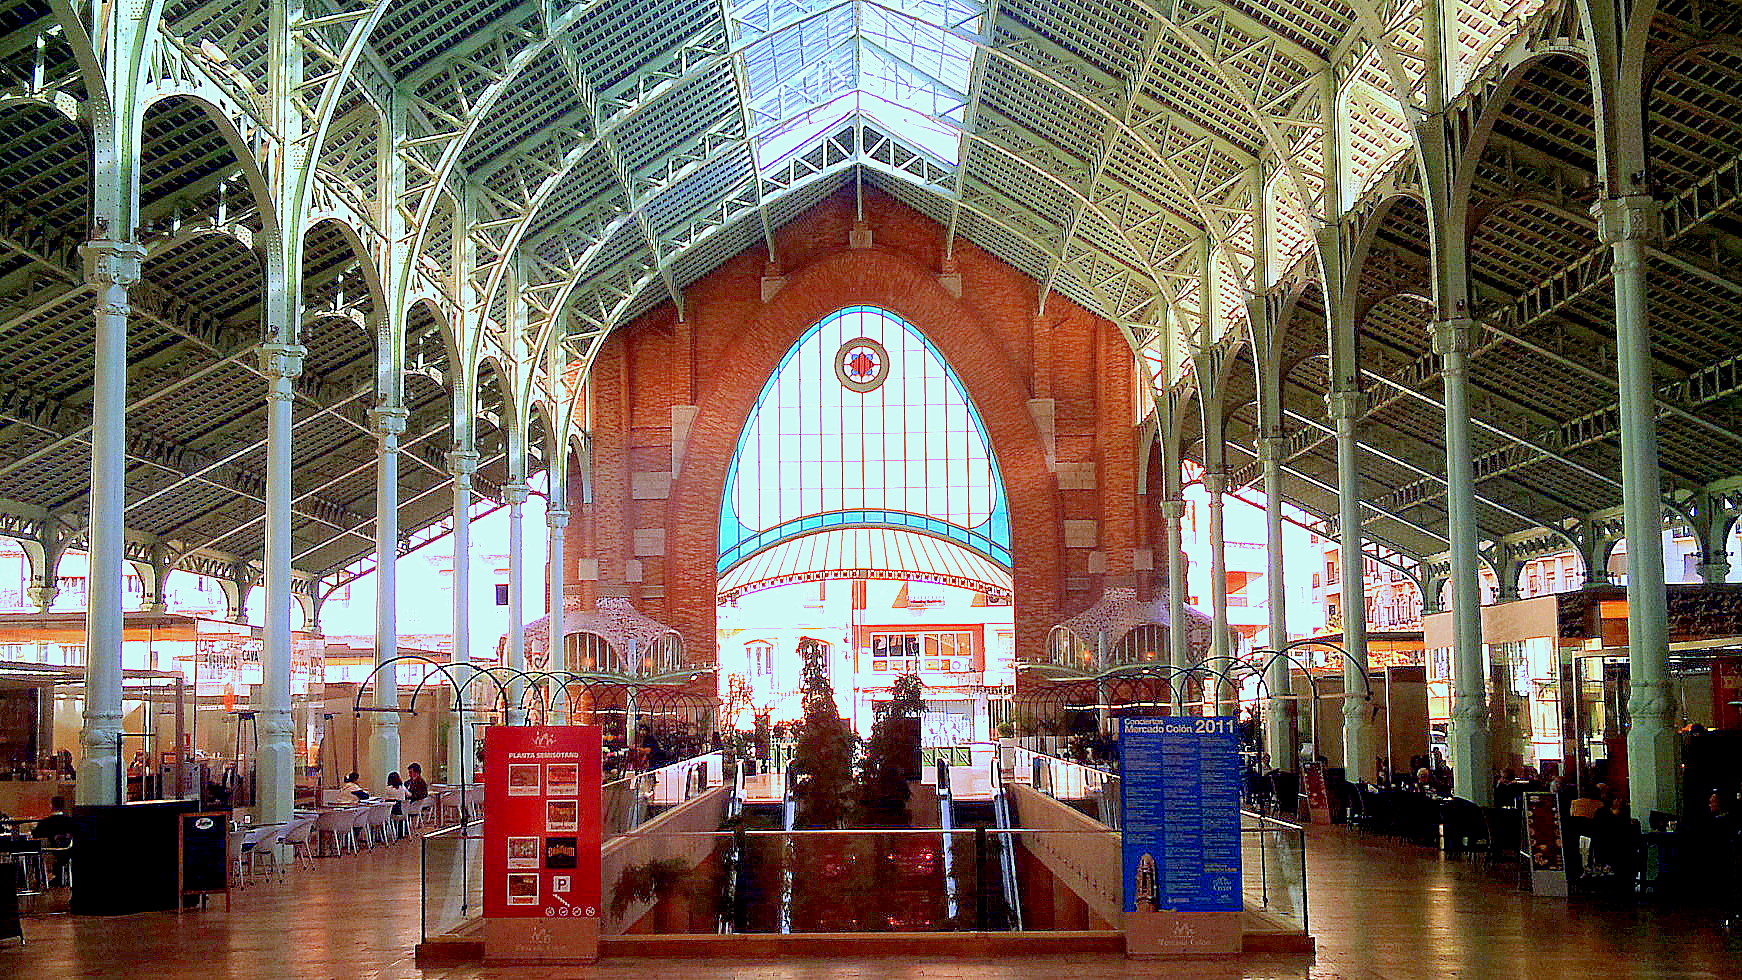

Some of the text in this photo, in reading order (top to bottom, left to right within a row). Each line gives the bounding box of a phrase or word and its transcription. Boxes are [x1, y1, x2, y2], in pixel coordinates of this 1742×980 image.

[242, 650, 259, 662] CAVA
[1124, 724, 1193, 734] Mercado Colón
[1194, 719, 1234, 734] 2011
[557, 878, 567, 890] P
